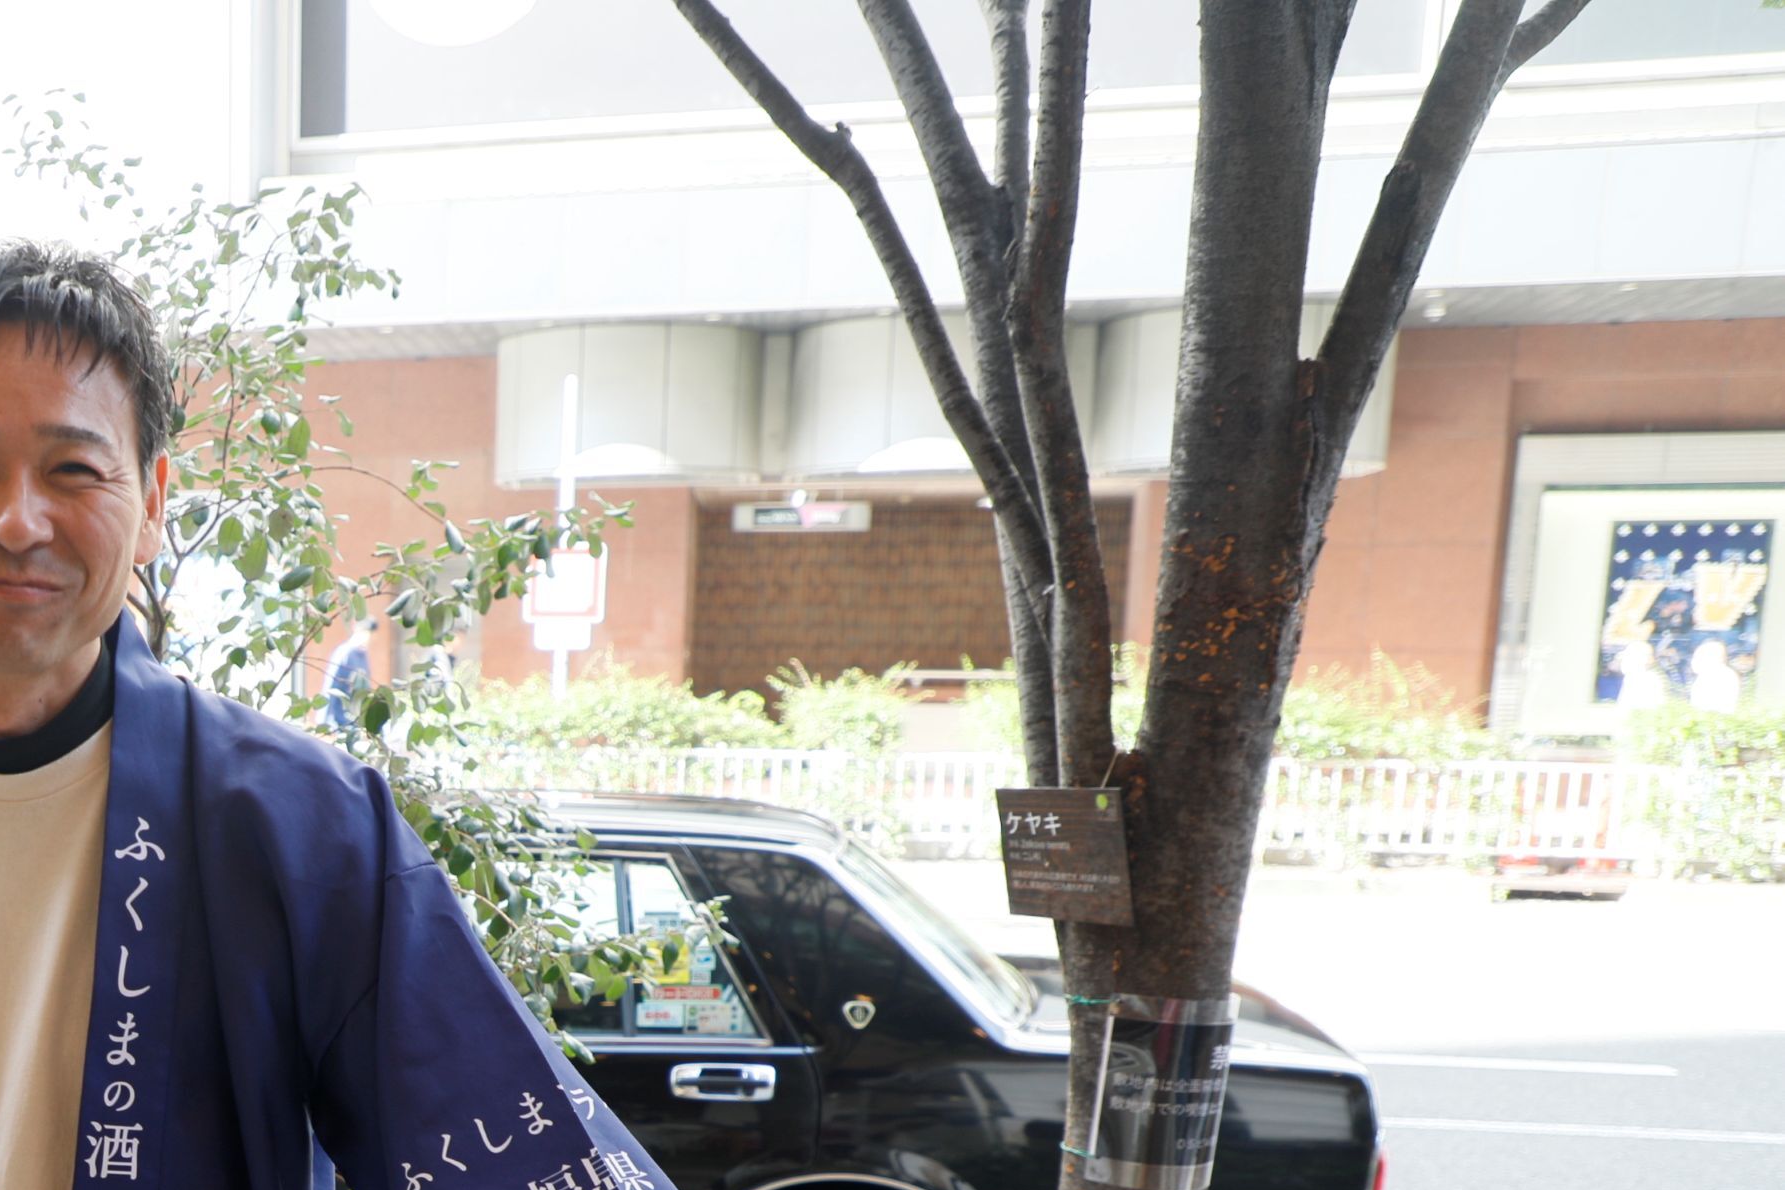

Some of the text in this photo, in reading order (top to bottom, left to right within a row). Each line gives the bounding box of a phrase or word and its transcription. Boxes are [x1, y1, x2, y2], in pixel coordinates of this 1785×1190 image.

[1006, 812, 1061, 836] ケヤキ
[85, 816, 165, 1180] ふくしまの酒
